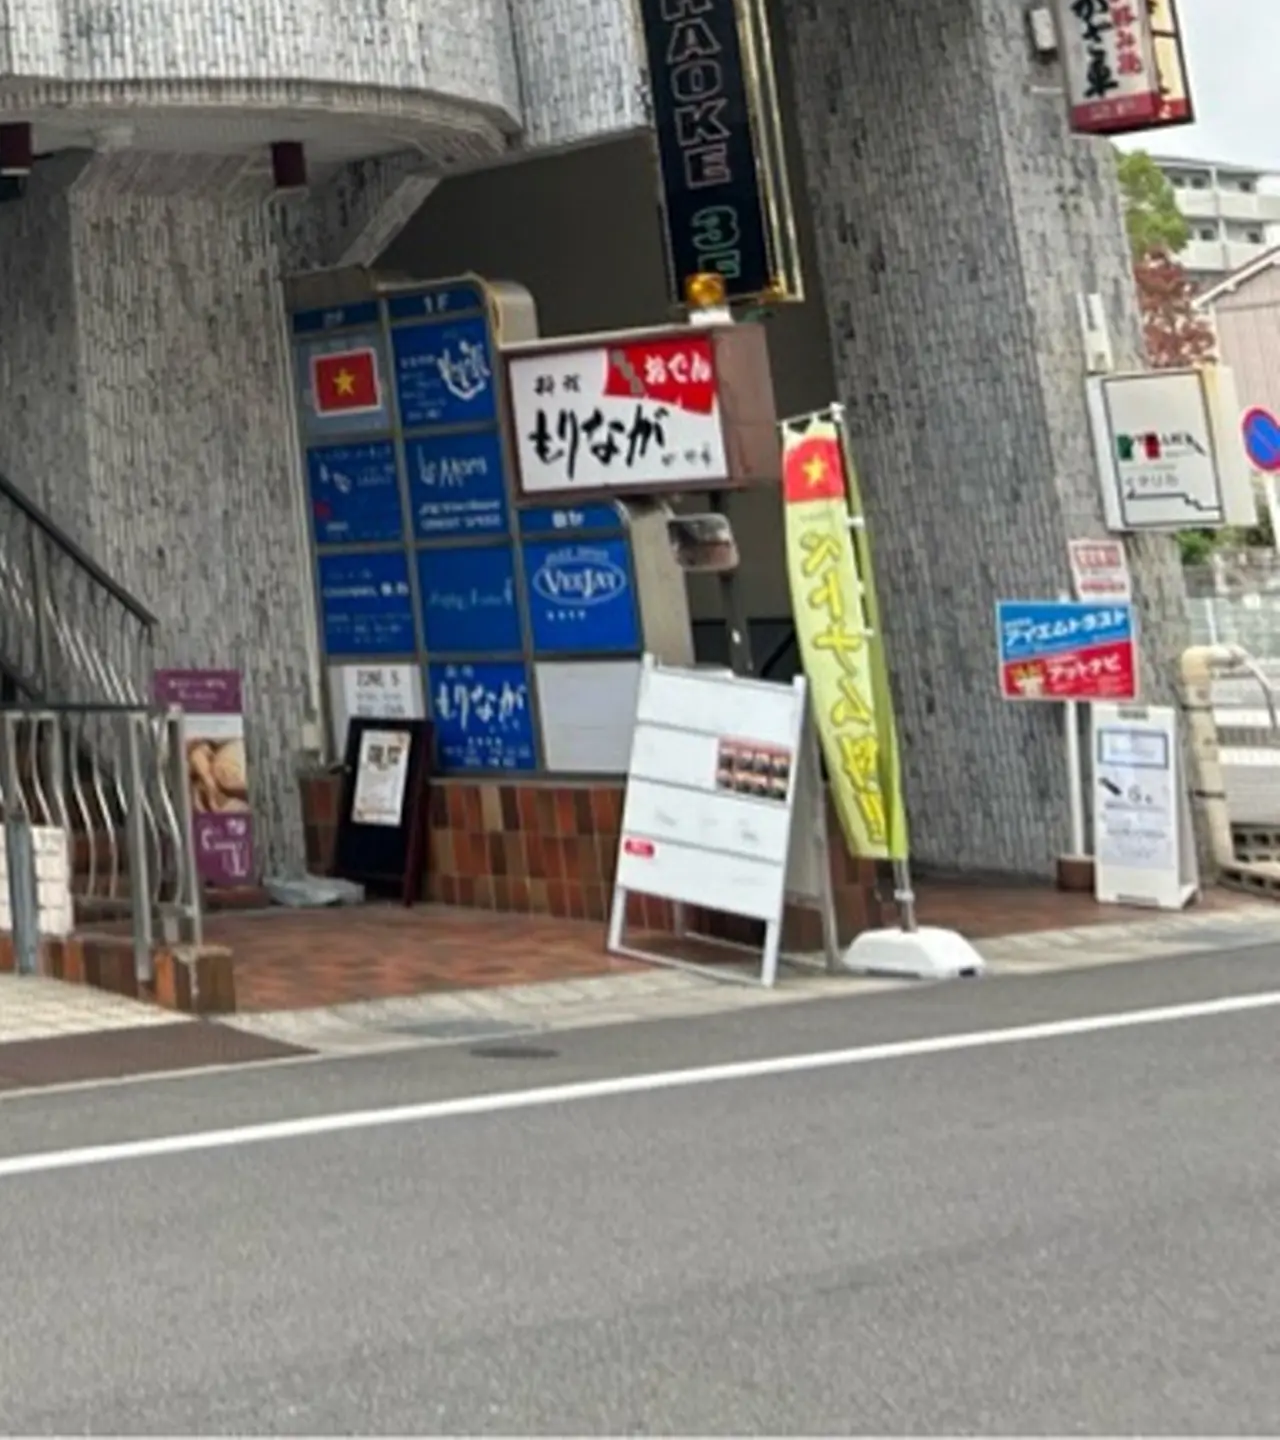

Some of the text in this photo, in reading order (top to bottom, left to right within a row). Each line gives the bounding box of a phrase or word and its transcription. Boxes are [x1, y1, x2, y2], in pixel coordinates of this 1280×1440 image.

[423, 293, 450, 314] 1F
[643, 351, 712, 386] おでん
[528, 403, 669, 480] もりなが
